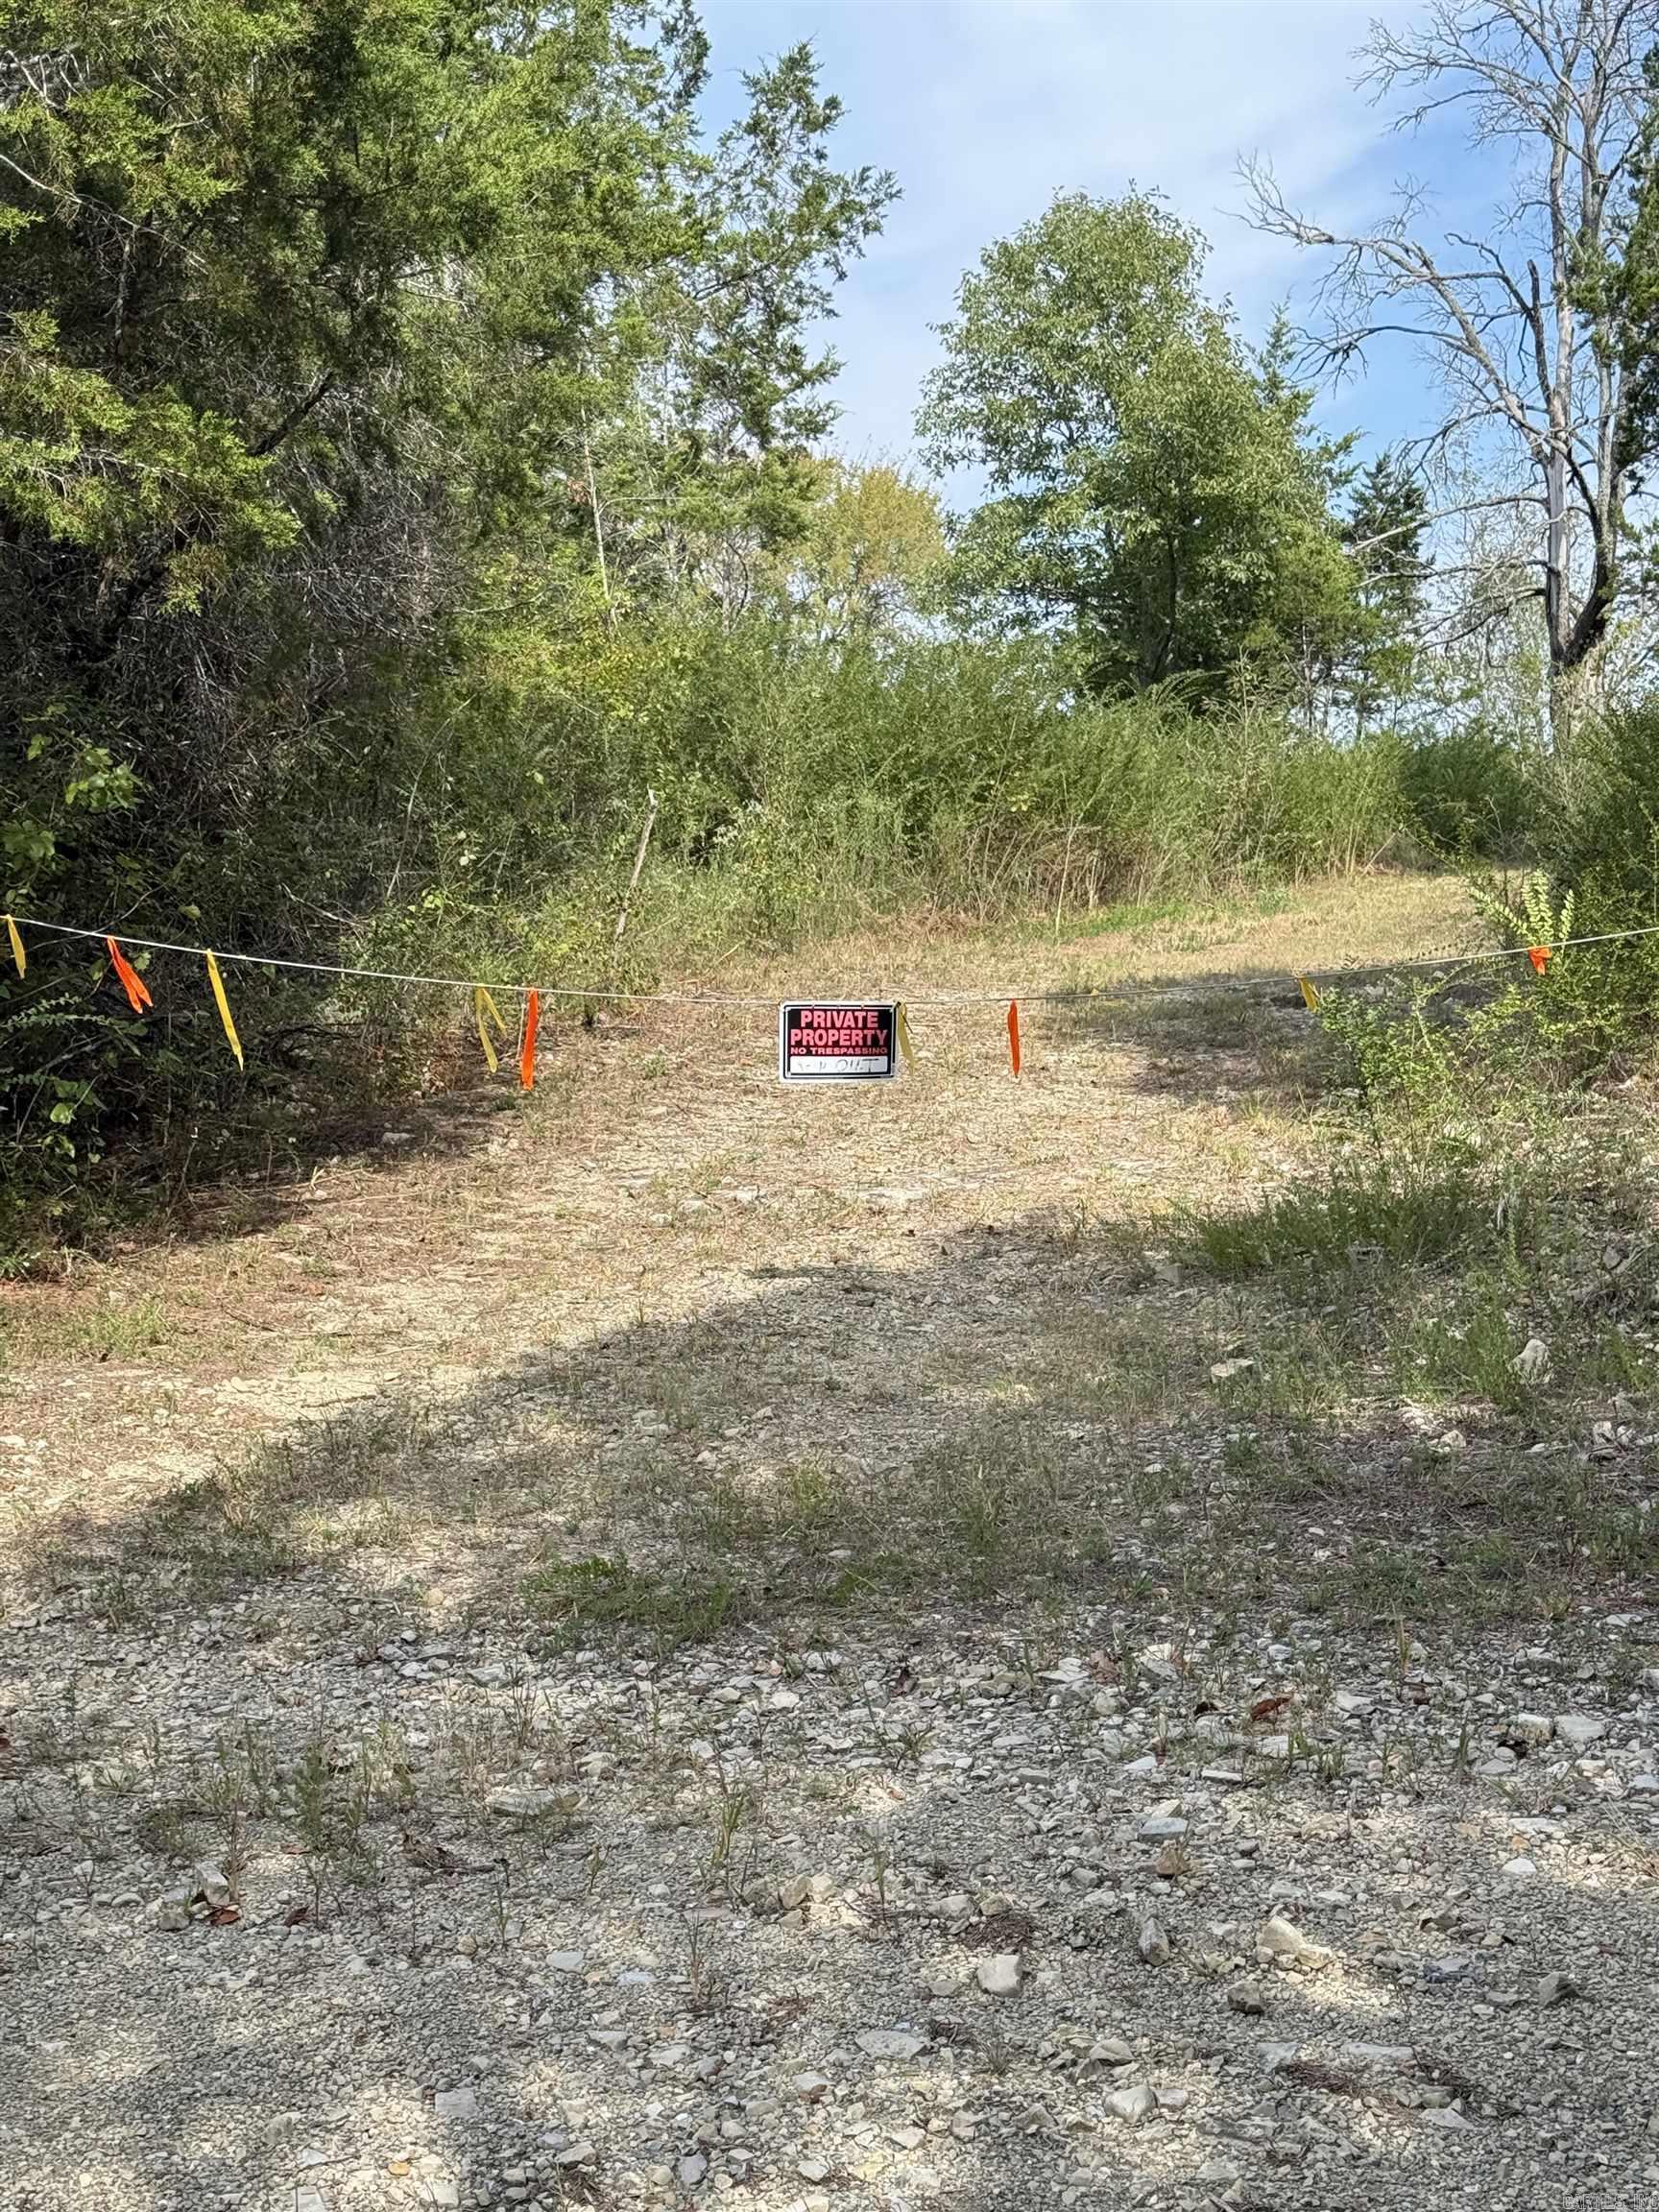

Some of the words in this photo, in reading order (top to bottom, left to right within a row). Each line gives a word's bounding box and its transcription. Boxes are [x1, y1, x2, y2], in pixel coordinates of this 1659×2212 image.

[800, 1010, 879, 1028] PRIVATE
[790, 1028, 888, 1046] PROPERTY
[790, 1046, 807, 1055] NO
[809, 1046, 888, 1055] TRESPASSING
